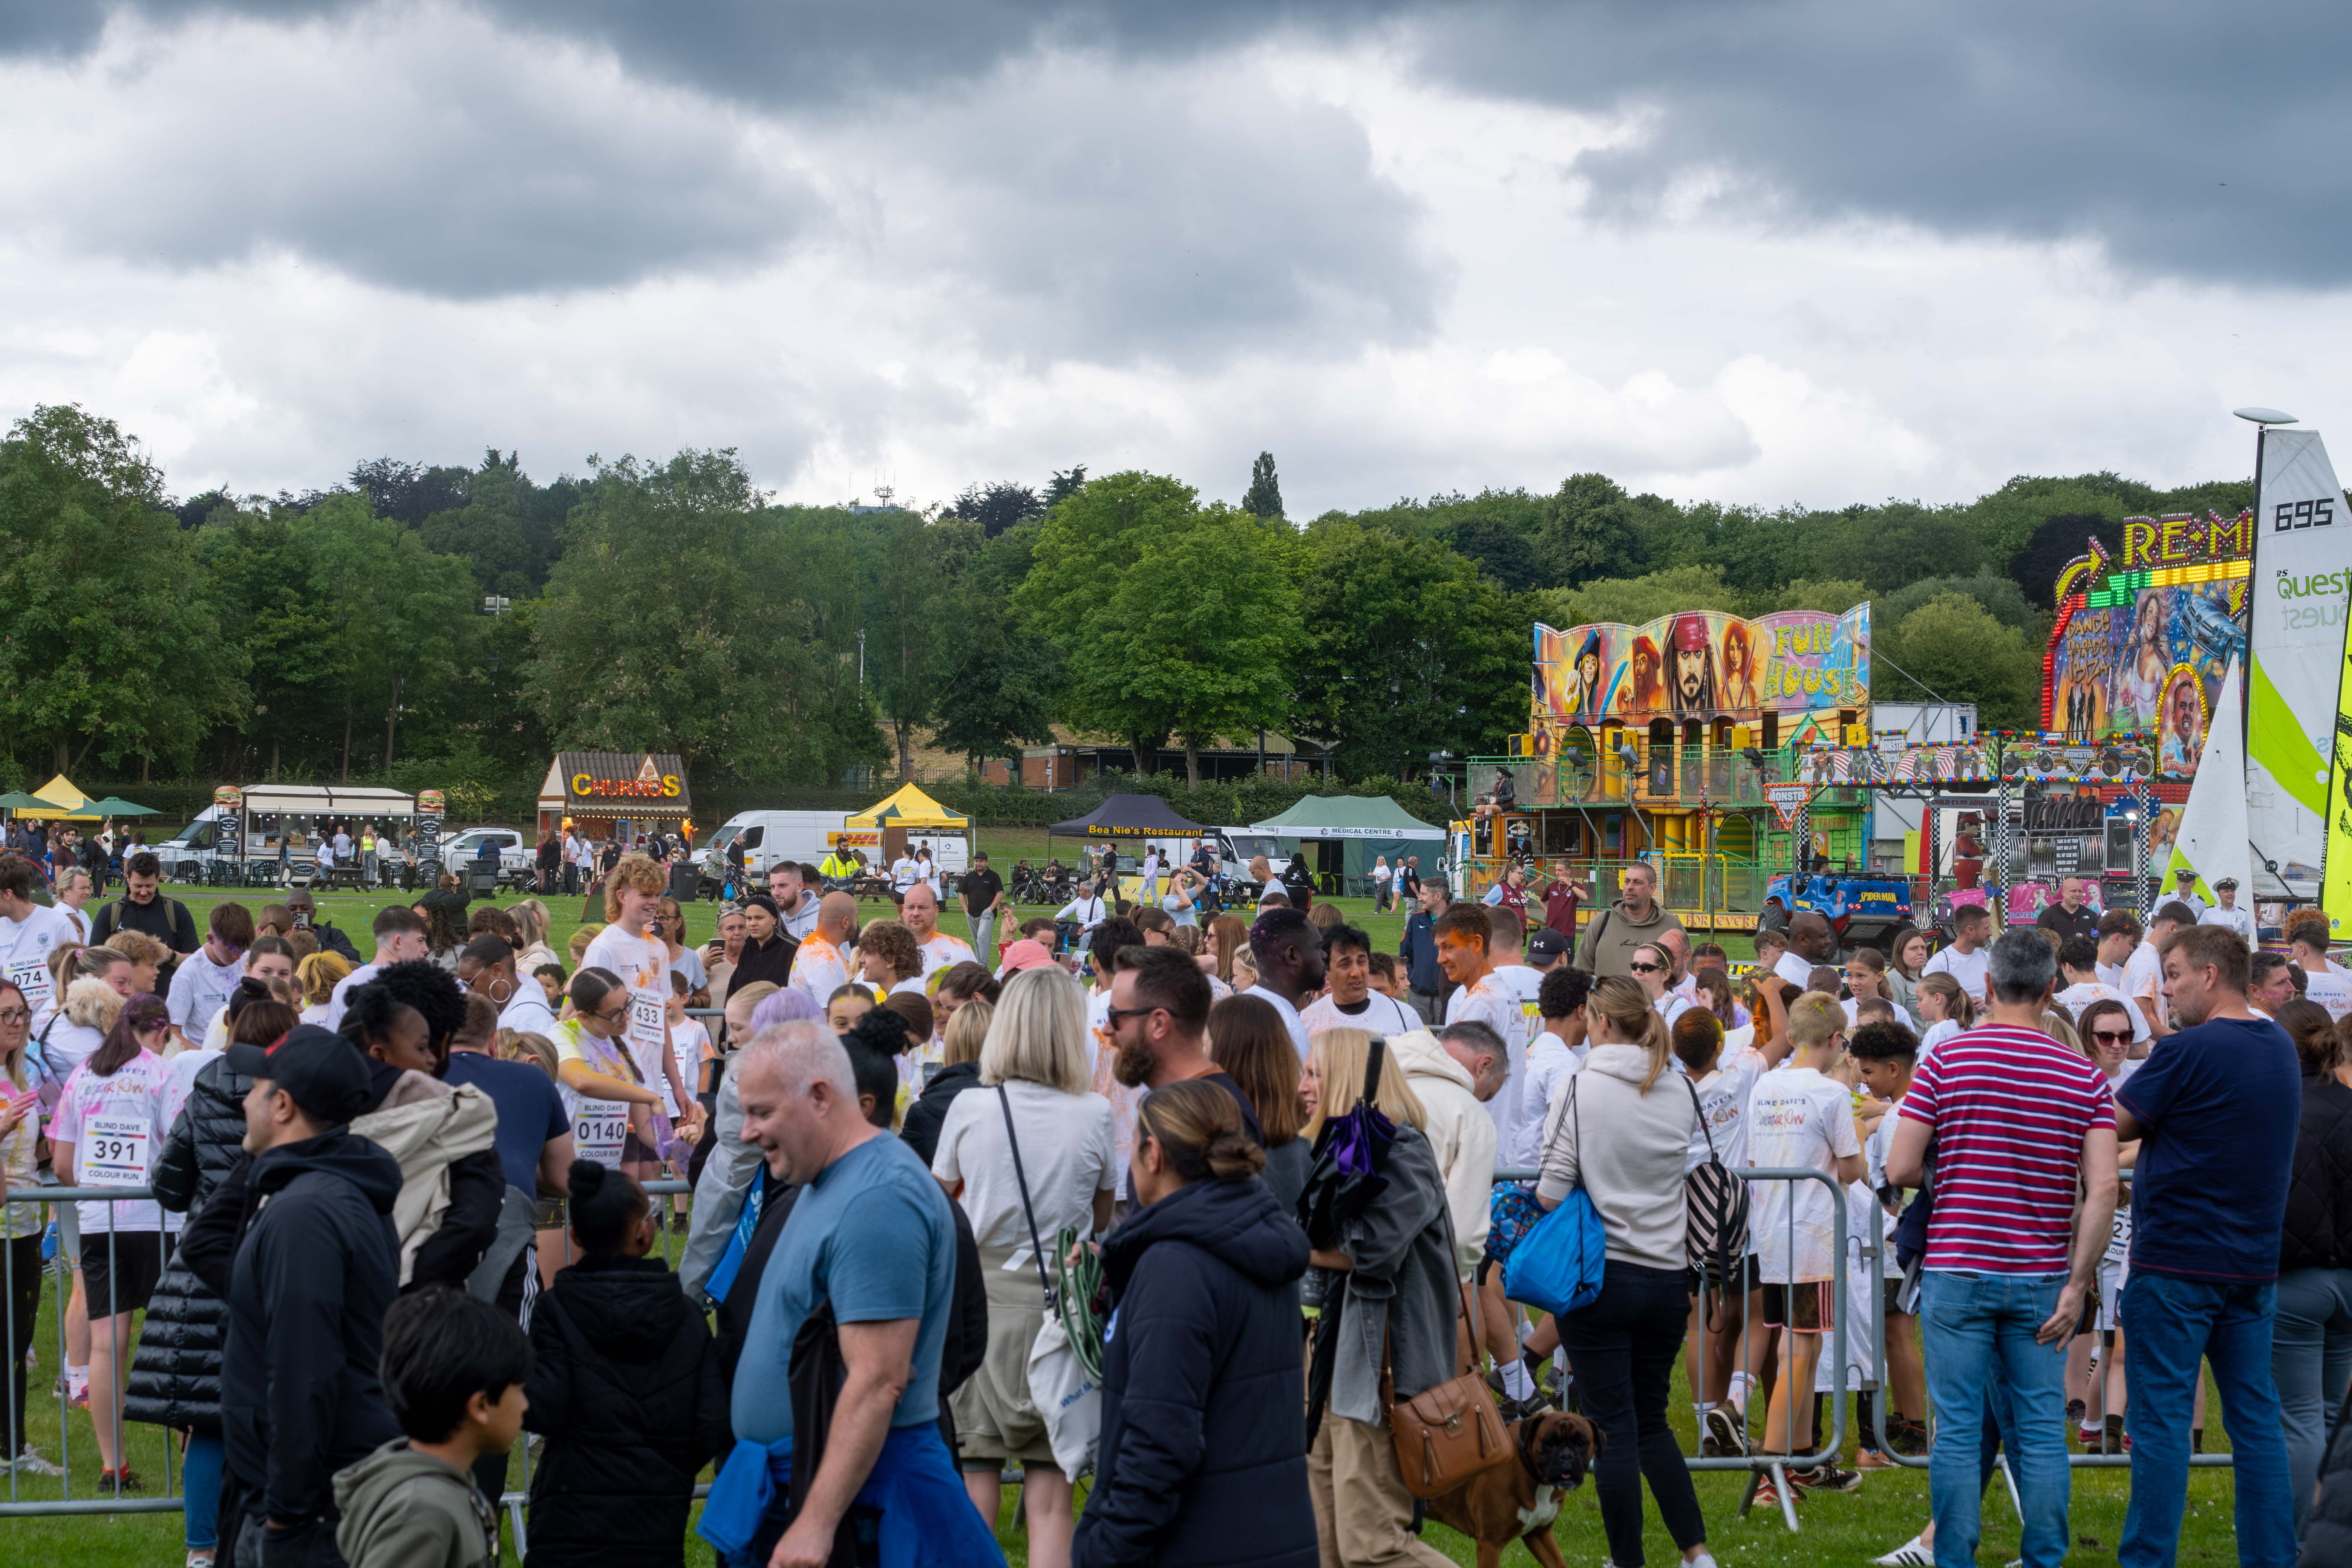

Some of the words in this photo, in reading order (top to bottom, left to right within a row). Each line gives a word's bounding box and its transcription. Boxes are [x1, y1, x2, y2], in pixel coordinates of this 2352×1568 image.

[2275, 498, 2334, 531] 695
[1773, 622, 1833, 657] FUN
[1762, 658, 1858, 701] HOUSE
[572, 773, 680, 797] CHURROS
[1819, 815, 1848, 828] TAVERN
[1089, 825, 1109, 834] Bea
[1143, 827, 1203, 836] Restaurant
[836, 834, 880, 845] DHL
[1859, 892, 1897, 903] SPIDER-MAN
[1686, 914, 1708, 926] FOR
[636, 1006, 657, 1023] 433
[578, 1122, 625, 1140] 0140
[94, 1140, 135, 1161] 391
[88, 1170, 121, 1179] COLOUR
